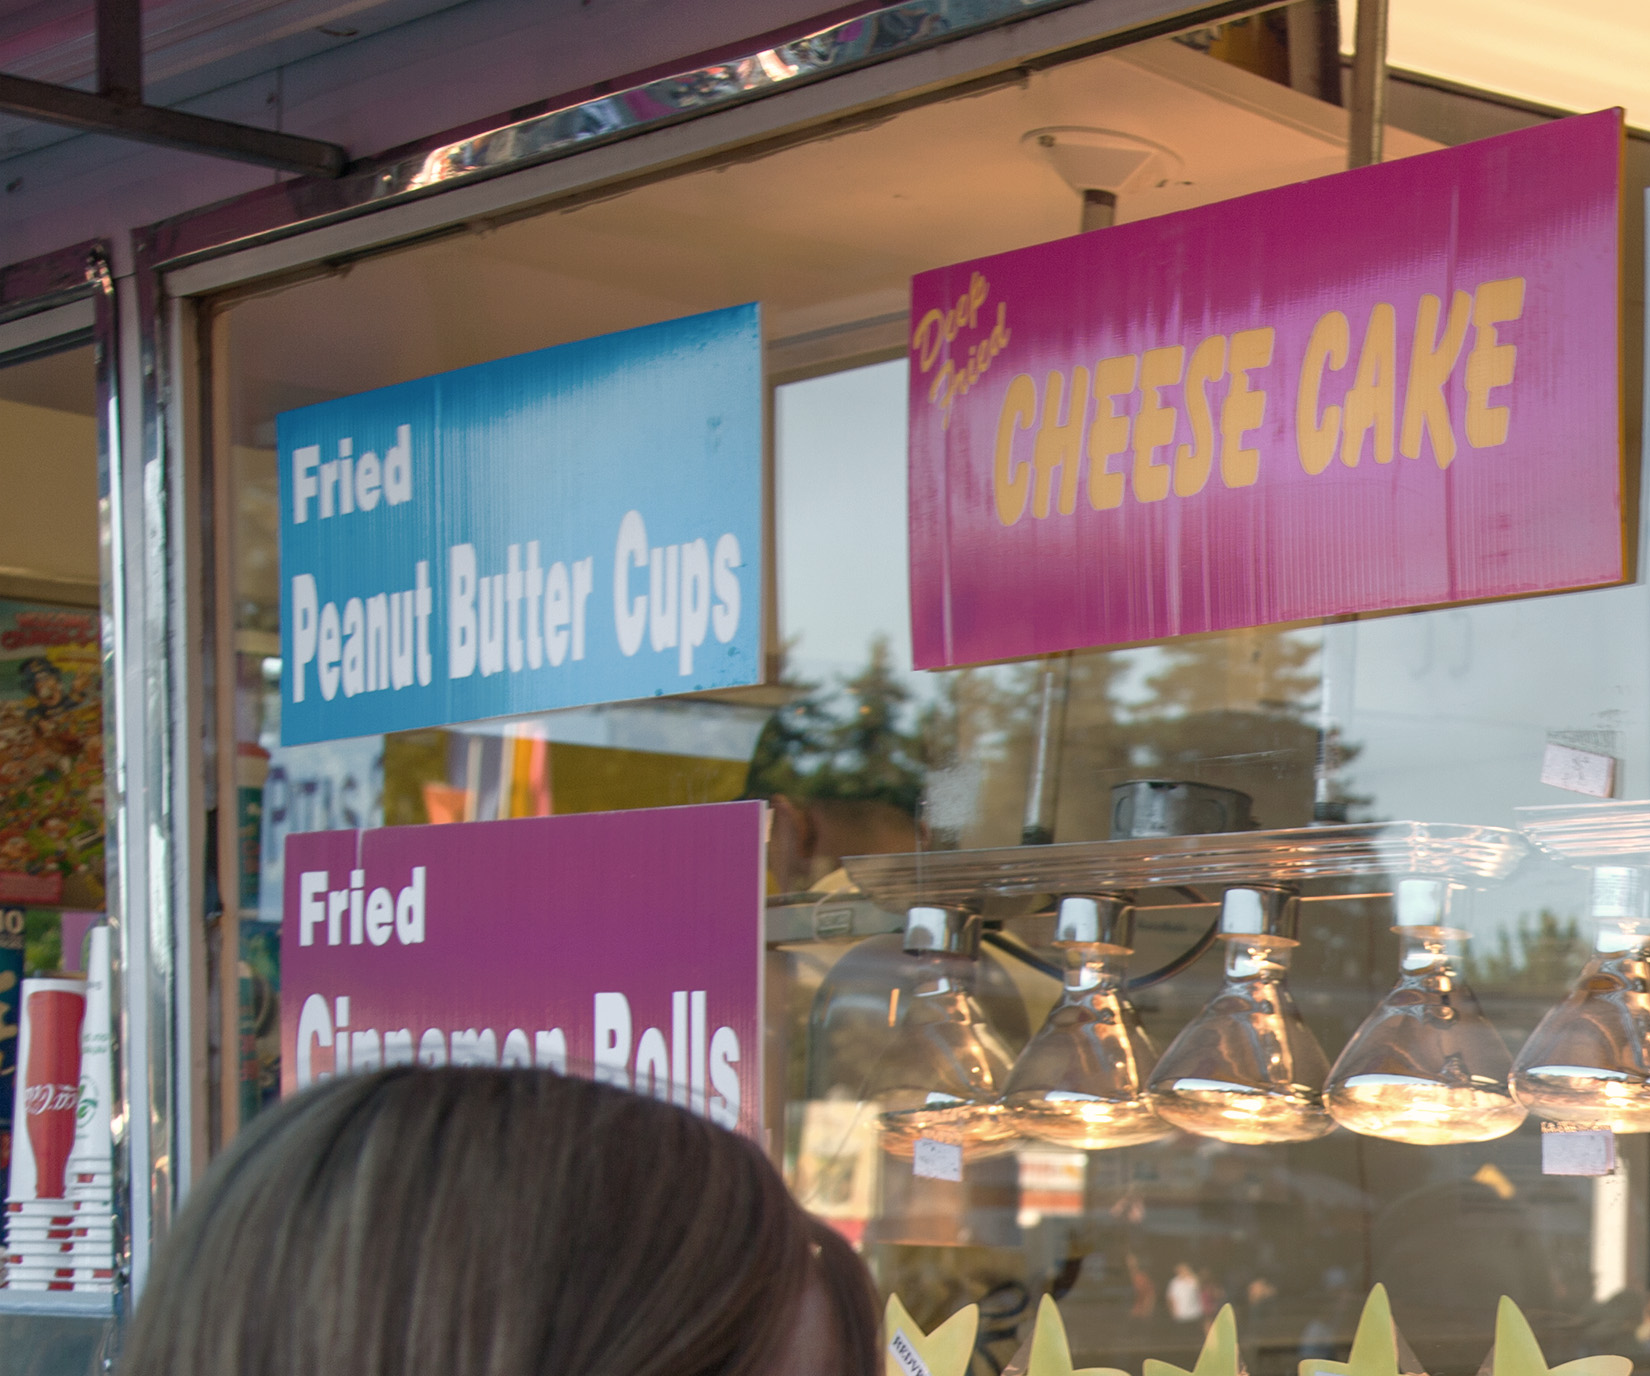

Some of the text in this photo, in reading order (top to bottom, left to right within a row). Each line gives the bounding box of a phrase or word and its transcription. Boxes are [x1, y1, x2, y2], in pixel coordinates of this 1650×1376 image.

[912, 271, 991, 373] Deep
[994, 276, 1526, 526] CHEESE CAKE
[292, 424, 412, 524] Fried
[291, 509, 743, 703] Peanut Butter Cups
[299, 866, 427, 947] Fried
[593, 989, 742, 1132] Rolls
